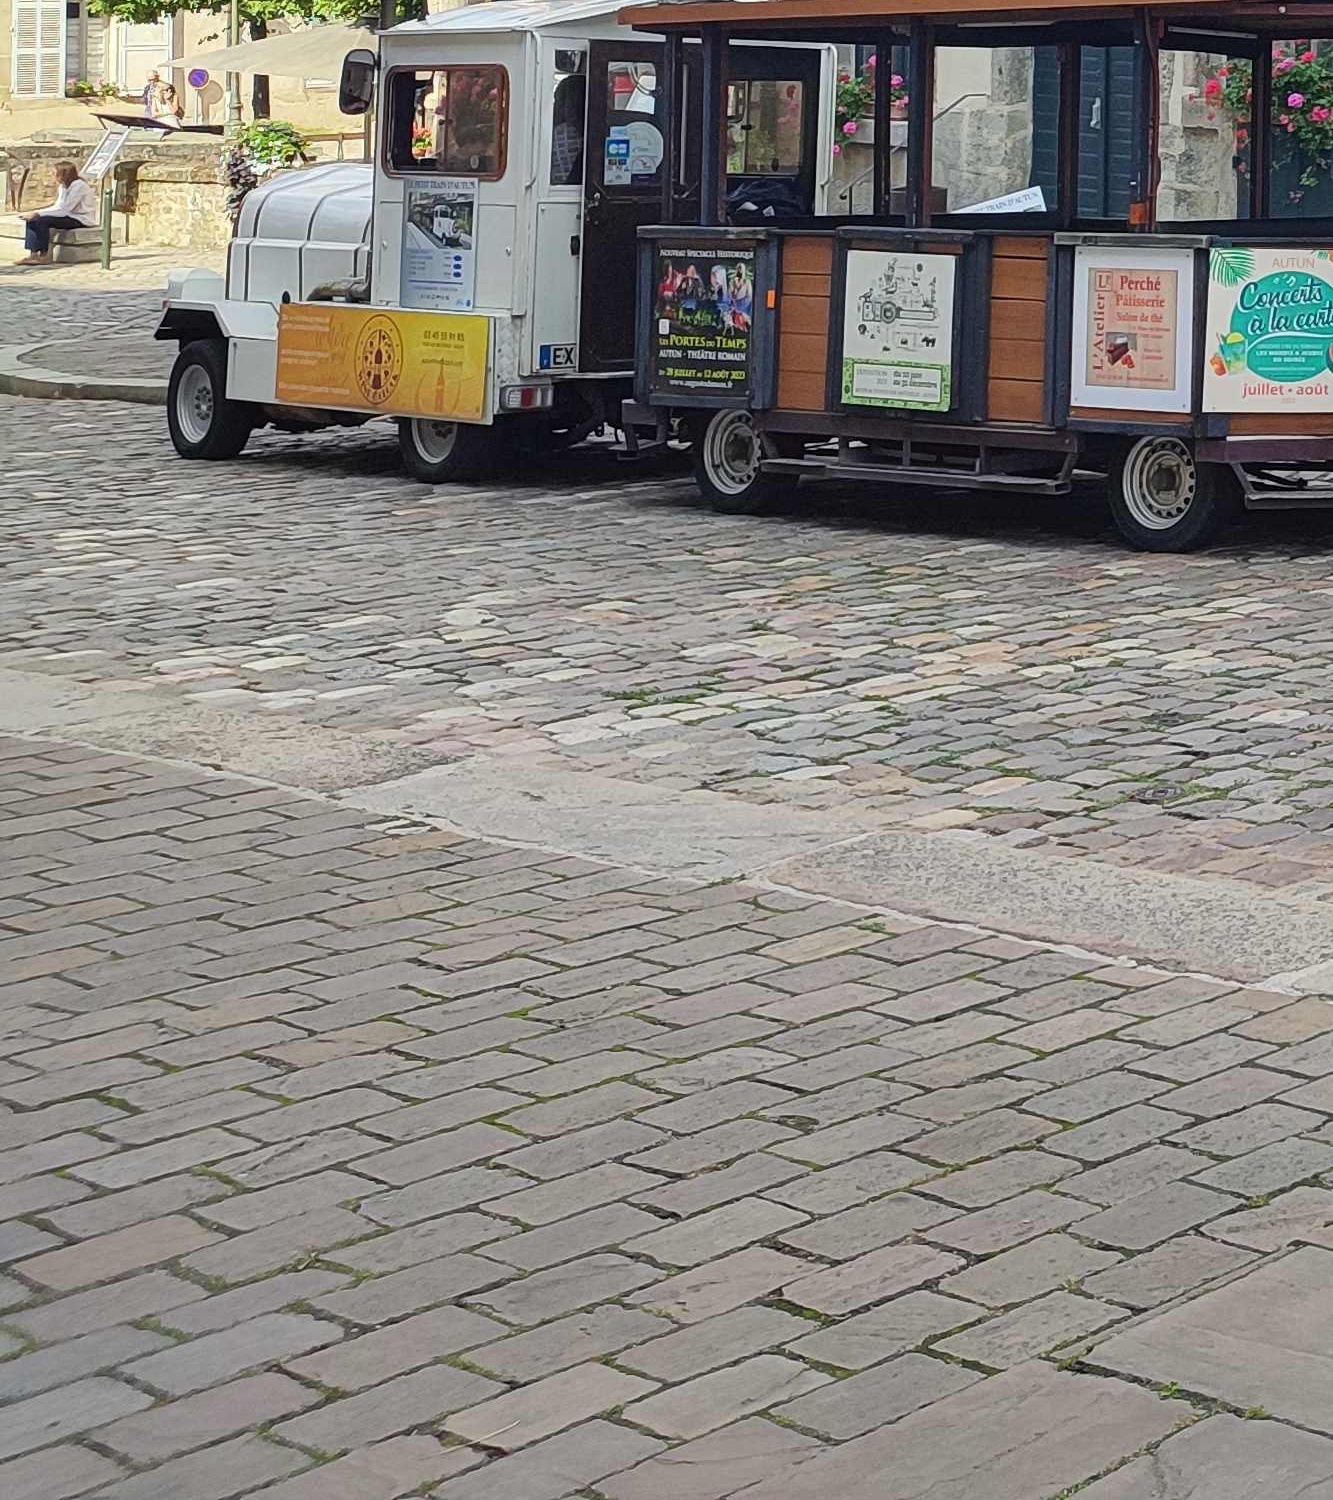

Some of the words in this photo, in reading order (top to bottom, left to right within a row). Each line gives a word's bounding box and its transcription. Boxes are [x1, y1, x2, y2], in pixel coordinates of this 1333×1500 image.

[1272, 257, 1315, 269] AUTUN
[1120, 275, 1161, 291] Perché
[1115, 293, 1165, 308] Pâtisserie
[1238, 277, 1324, 313] Concerts
[1248, 314, 1266, 335] à
[1268, 305, 1291, 333] la
[1092, 293, 1105, 371] L'Atelier
[552, 346, 575, 366] EX
[658, 349, 682, 358] AUTUN
[717, 351, 746, 361] ROMAIN
[1241, 383, 1285, 399] juillet
[1295, 383, 1329, 396] août
